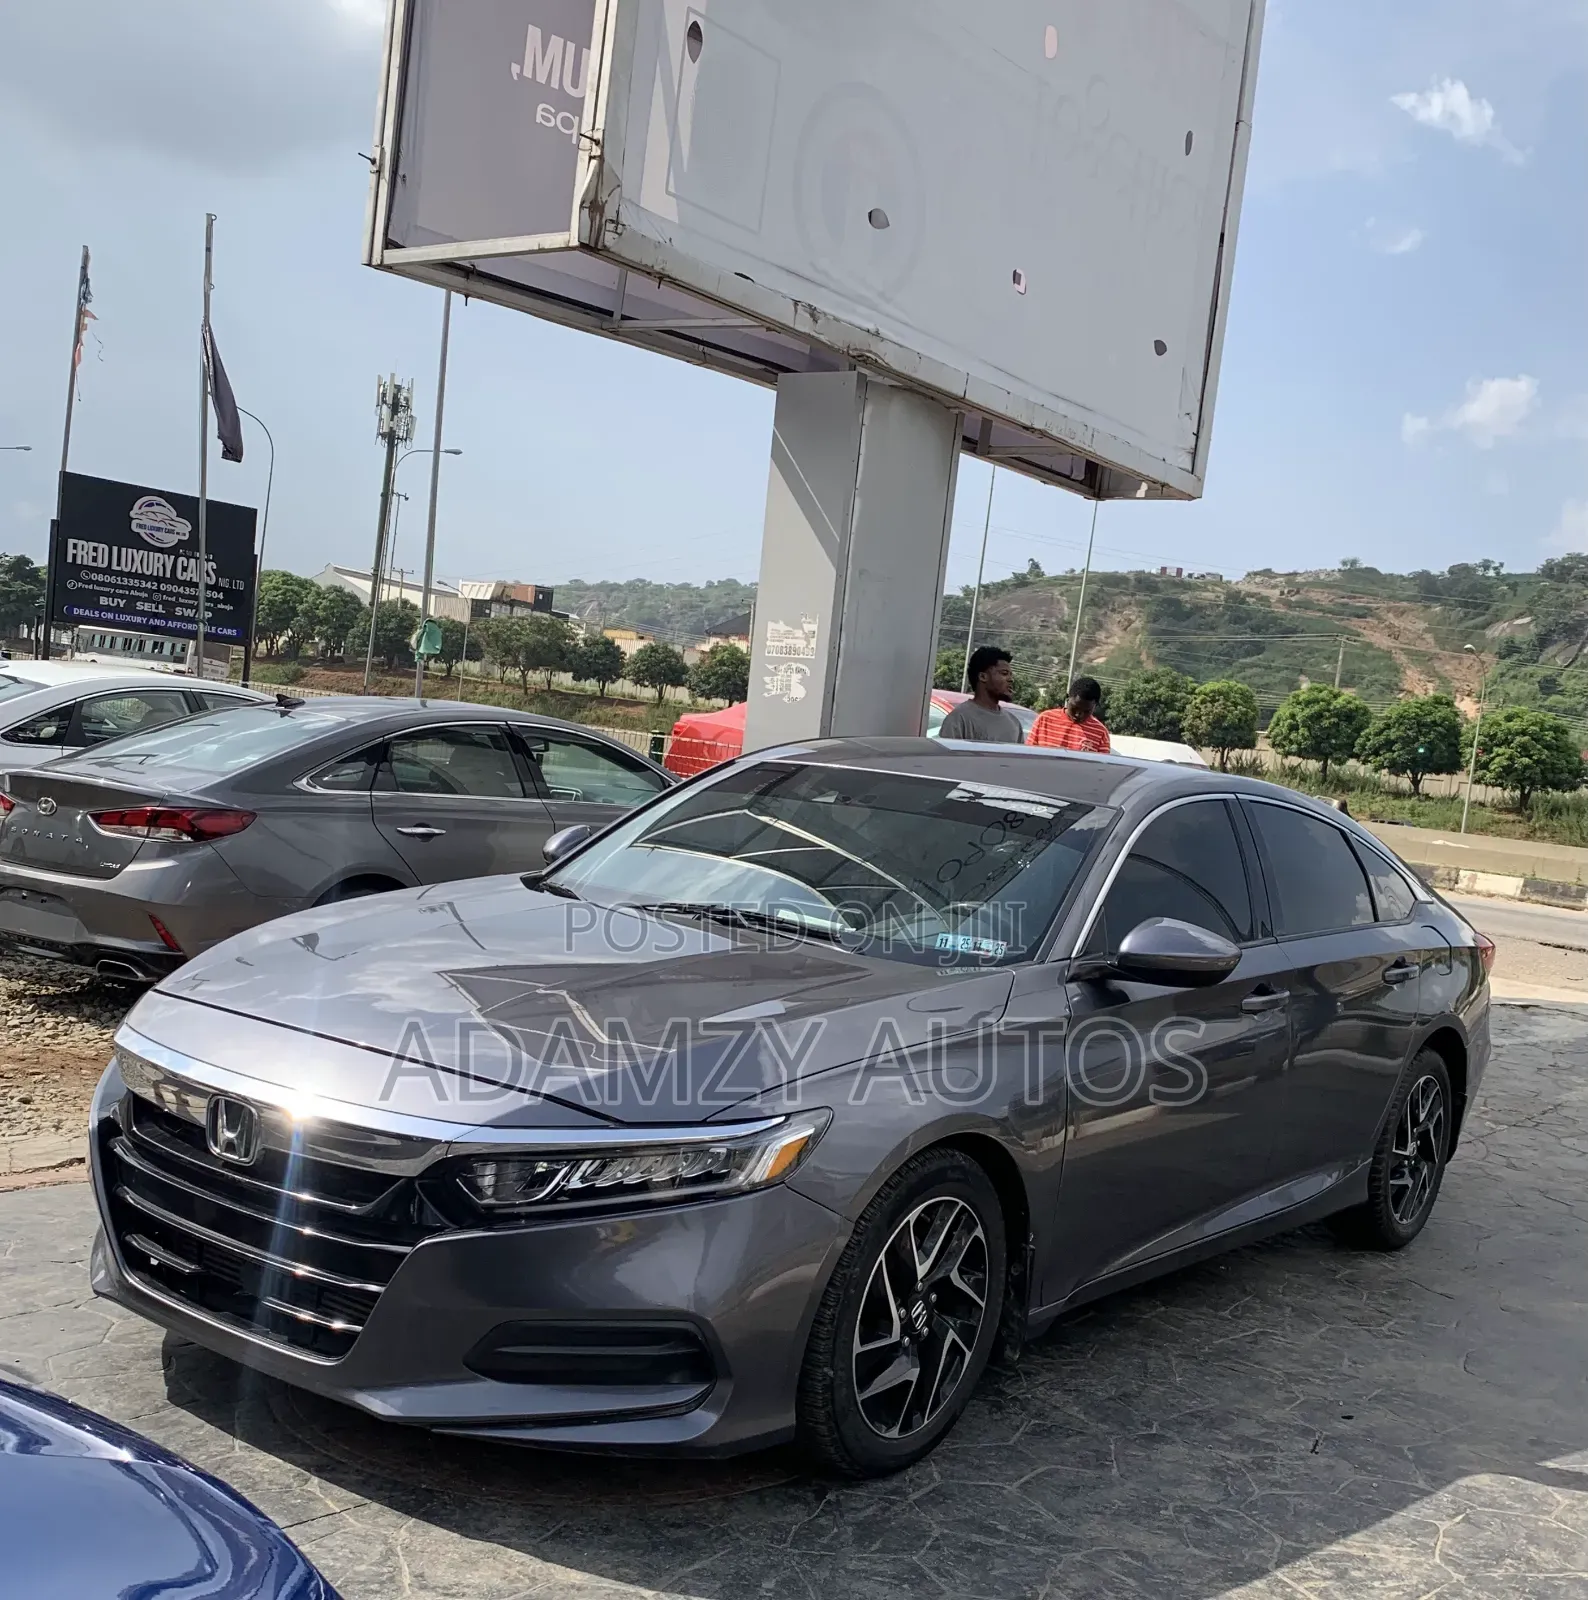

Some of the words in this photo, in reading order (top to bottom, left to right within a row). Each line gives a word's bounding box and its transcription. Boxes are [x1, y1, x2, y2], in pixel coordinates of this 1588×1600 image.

[66, 538, 109, 568] FRED
[111, 546, 175, 578] LUXURY
[91, 573, 158, 590] 08061335342
[160, 583, 224, 600] 0904357504
[93, 585, 115, 594] luxury
[129, 589, 149, 598] Abuja
[218, 577, 231, 588] NIG.
[232, 579, 245, 590] LTD
[99, 596, 127, 608] BUY
[135, 601, 166, 614] SELL
[73, 607, 100, 618] DEALS
[100, 611, 114, 620] ON
[115, 613, 147, 624] LUXURY
[148, 618, 166, 627] AND
[167, 621, 217, 633] AFFORDBLE
[217, 627, 237, 636] CARS
[10, 826, 83, 844] SONATA
[960, 937, 971, 950] 25
